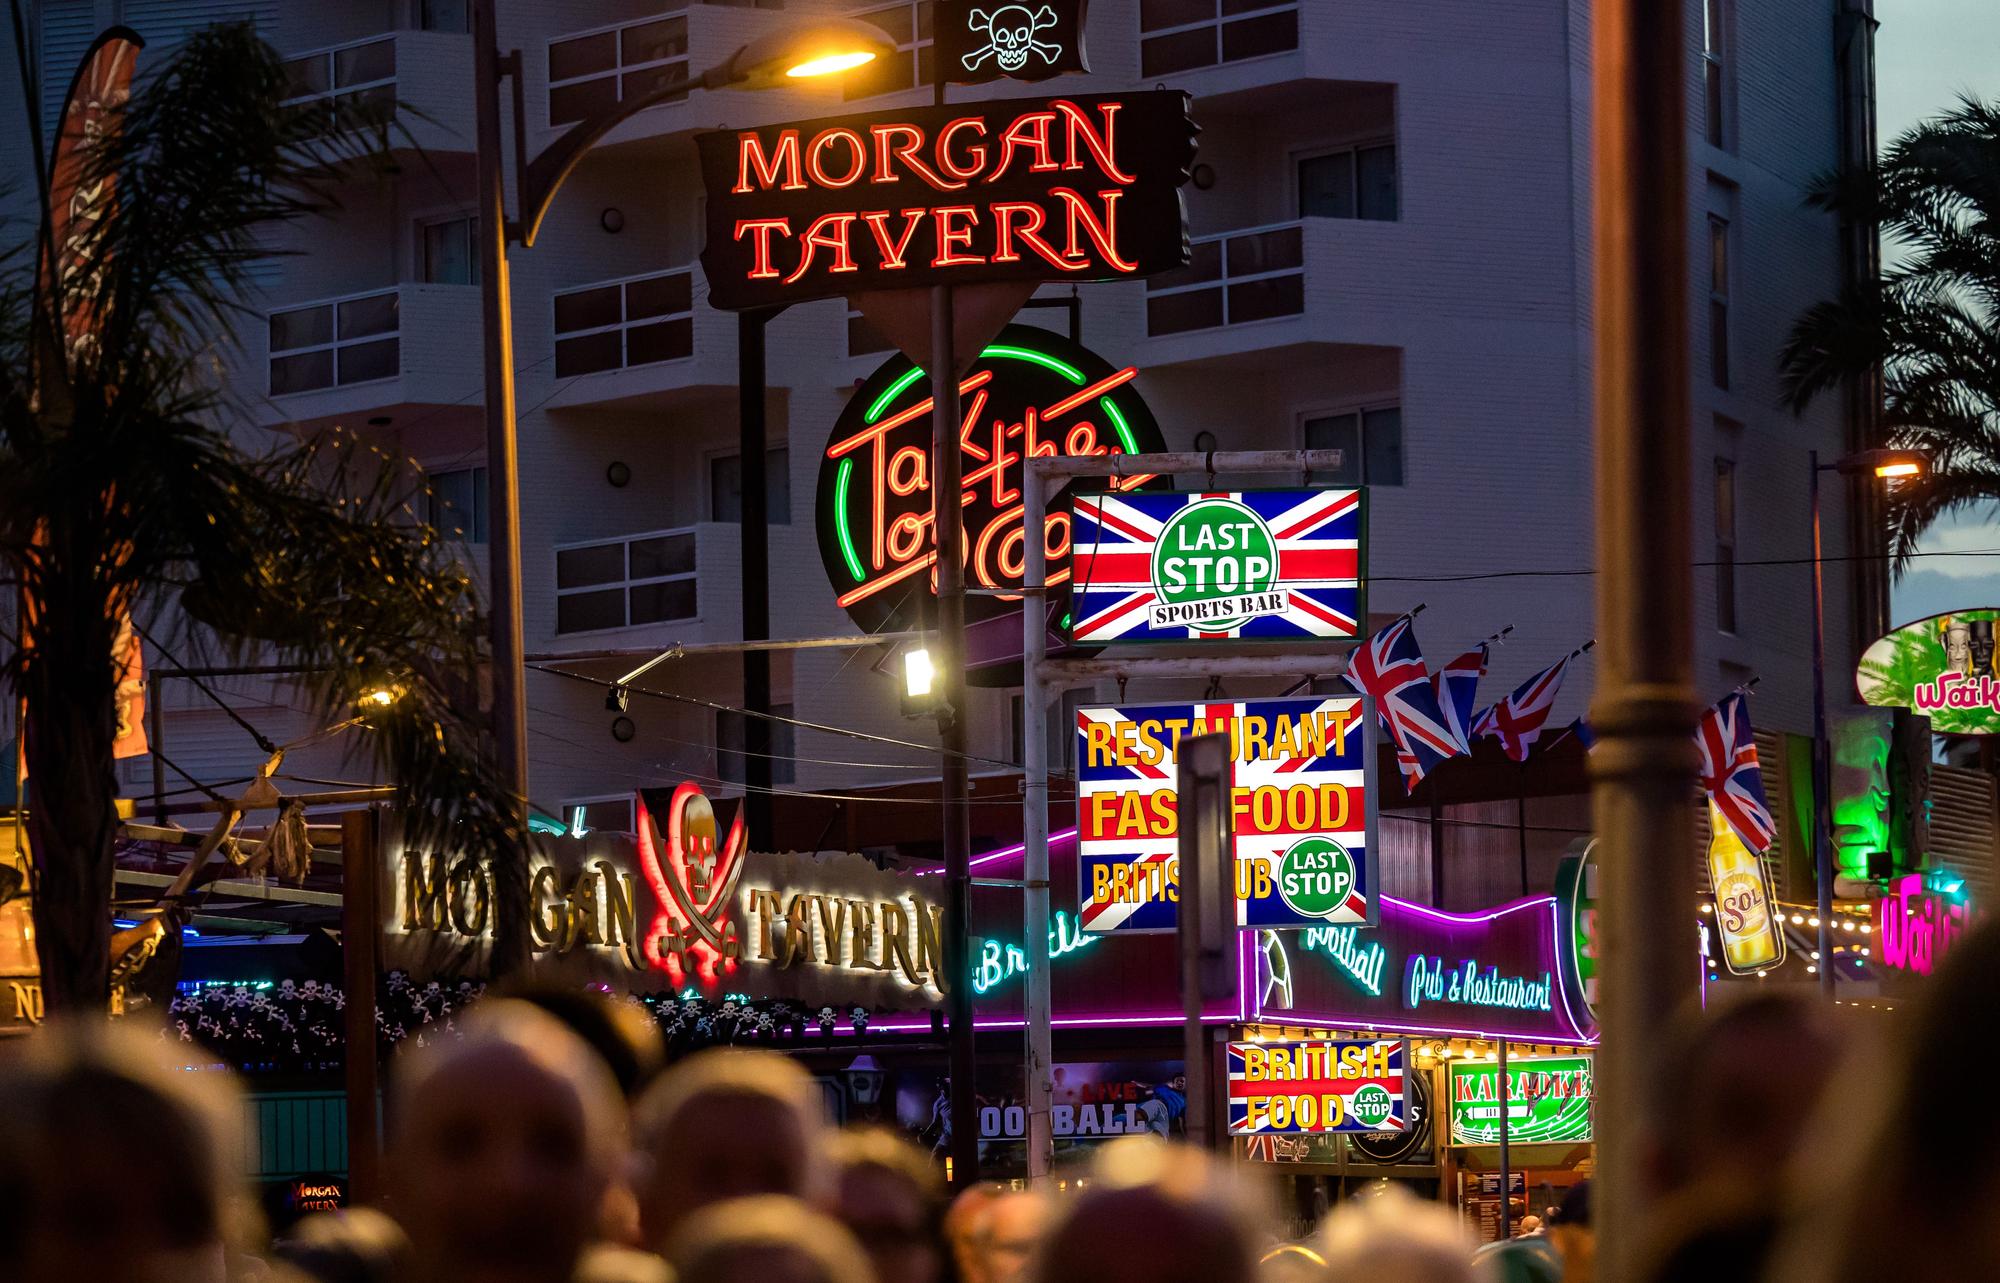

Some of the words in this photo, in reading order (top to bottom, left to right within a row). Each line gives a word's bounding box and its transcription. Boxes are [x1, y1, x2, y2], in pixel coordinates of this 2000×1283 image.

[732, 100, 1139, 194] MORGAN
[733, 186, 1140, 286] TAVERN
[1178, 522, 1255, 552] LAST
[1163, 556, 1271, 595] STOP
[1155, 597, 1234, 625] SPORTS
[1240, 592, 1284, 614] BAR
[1091, 787, 1179, 838] FAS
[1293, 851, 1340, 870] LAST
[1234, 858, 1273, 901] UB
[1284, 871, 1350, 897] STOP
[750, 889, 949, 994] TAVERN
[1411, 953, 1445, 1009] Pub
[1449, 968, 1462, 1003] &
[1463, 958, 1552, 1012] Restaurant
[1244, 1045, 1390, 1082] BRITISH
[1247, 1093, 1345, 1130] FOOD
[1355, 1103, 1390, 1117] STOP
[1360, 1092, 1385, 1103] LAST
[978, 1103, 1147, 1137] OOBALL
